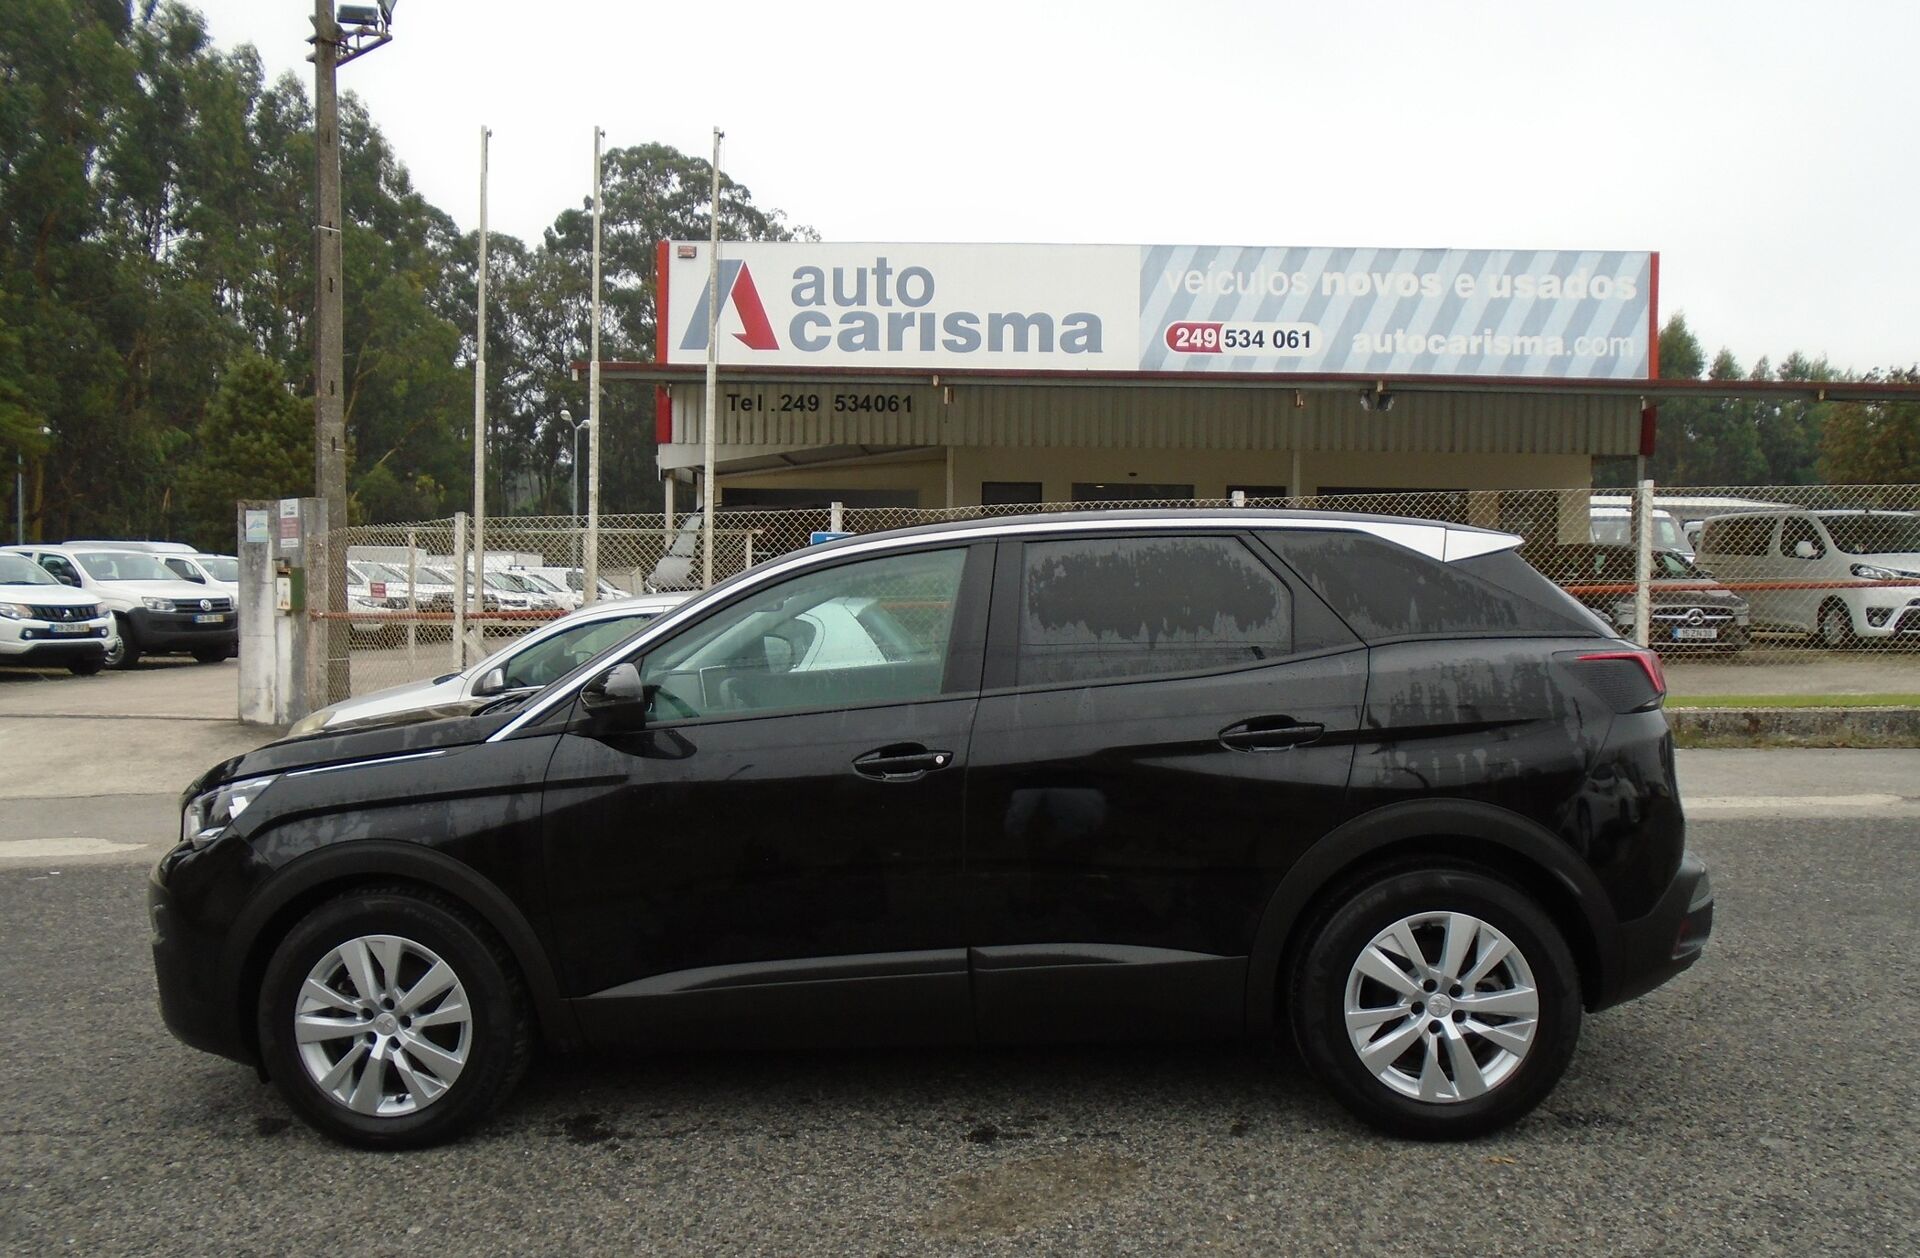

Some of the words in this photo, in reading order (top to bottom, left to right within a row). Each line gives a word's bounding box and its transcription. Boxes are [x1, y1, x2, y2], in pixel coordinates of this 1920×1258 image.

[790, 256, 936, 308] auto
[1163, 260, 1310, 297] veículos
[1321, 270, 1442, 298] novos
[1454, 271, 1476, 297] e
[1488, 267, 1638, 300] usados
[788, 310, 1104, 354] carisma
[1175, 327, 1218, 348] 249
[1224, 329, 1265, 349] 534
[1272, 329, 1311, 349] 061
[1351, 327, 1635, 358] autocarisma.com
[834, 394, 913, 413] 534061
